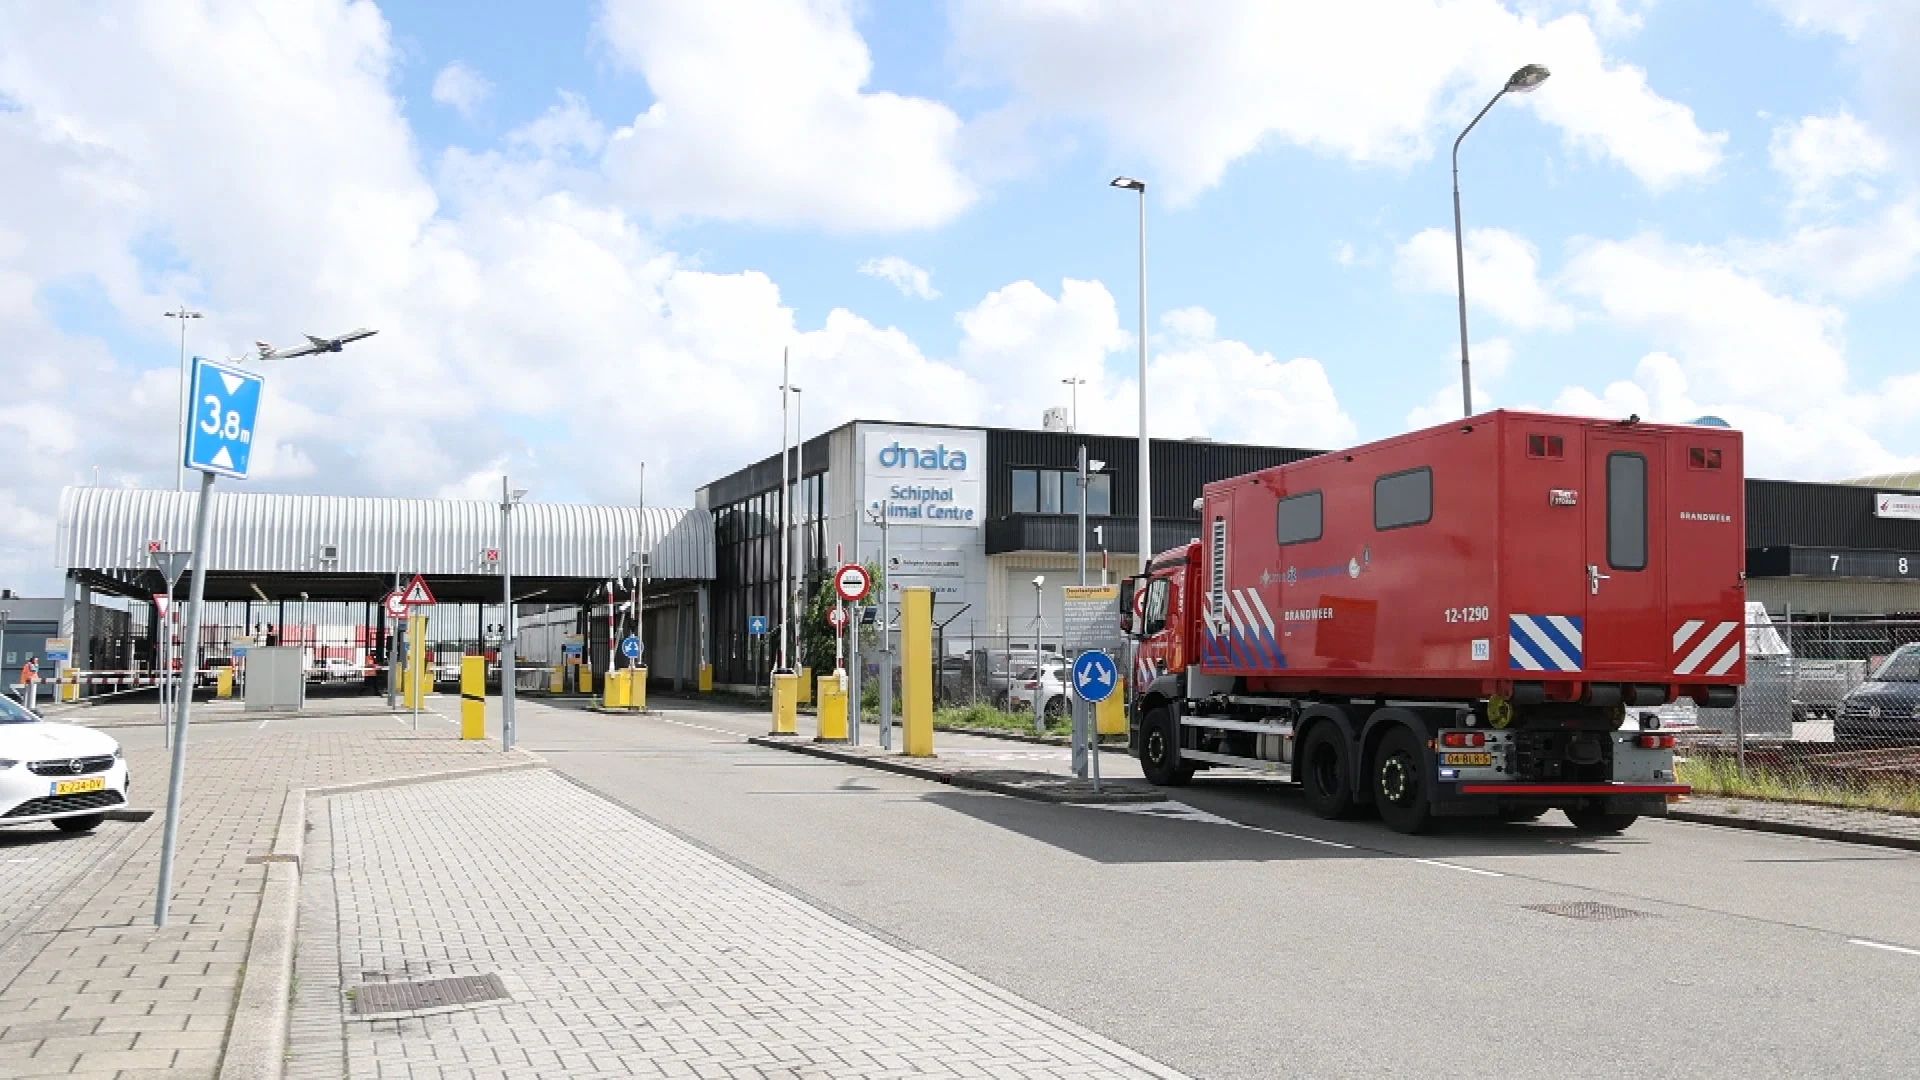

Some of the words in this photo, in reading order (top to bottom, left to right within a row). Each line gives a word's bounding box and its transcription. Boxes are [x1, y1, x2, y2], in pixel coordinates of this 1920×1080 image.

[880, 442, 967, 470] dnata
[891, 486, 953, 504] Schiphol
[927, 504, 973, 520] Centre
[1680, 511, 1731, 523] BRANDWEER
[1093, 525, 1103, 545] 1
[1830, 555, 1840, 571] 7
[1898, 557, 1909, 574] 8
[1284, 608, 1334, 621] BRANDWEER
[1445, 605, 1489, 623] 12-1290
